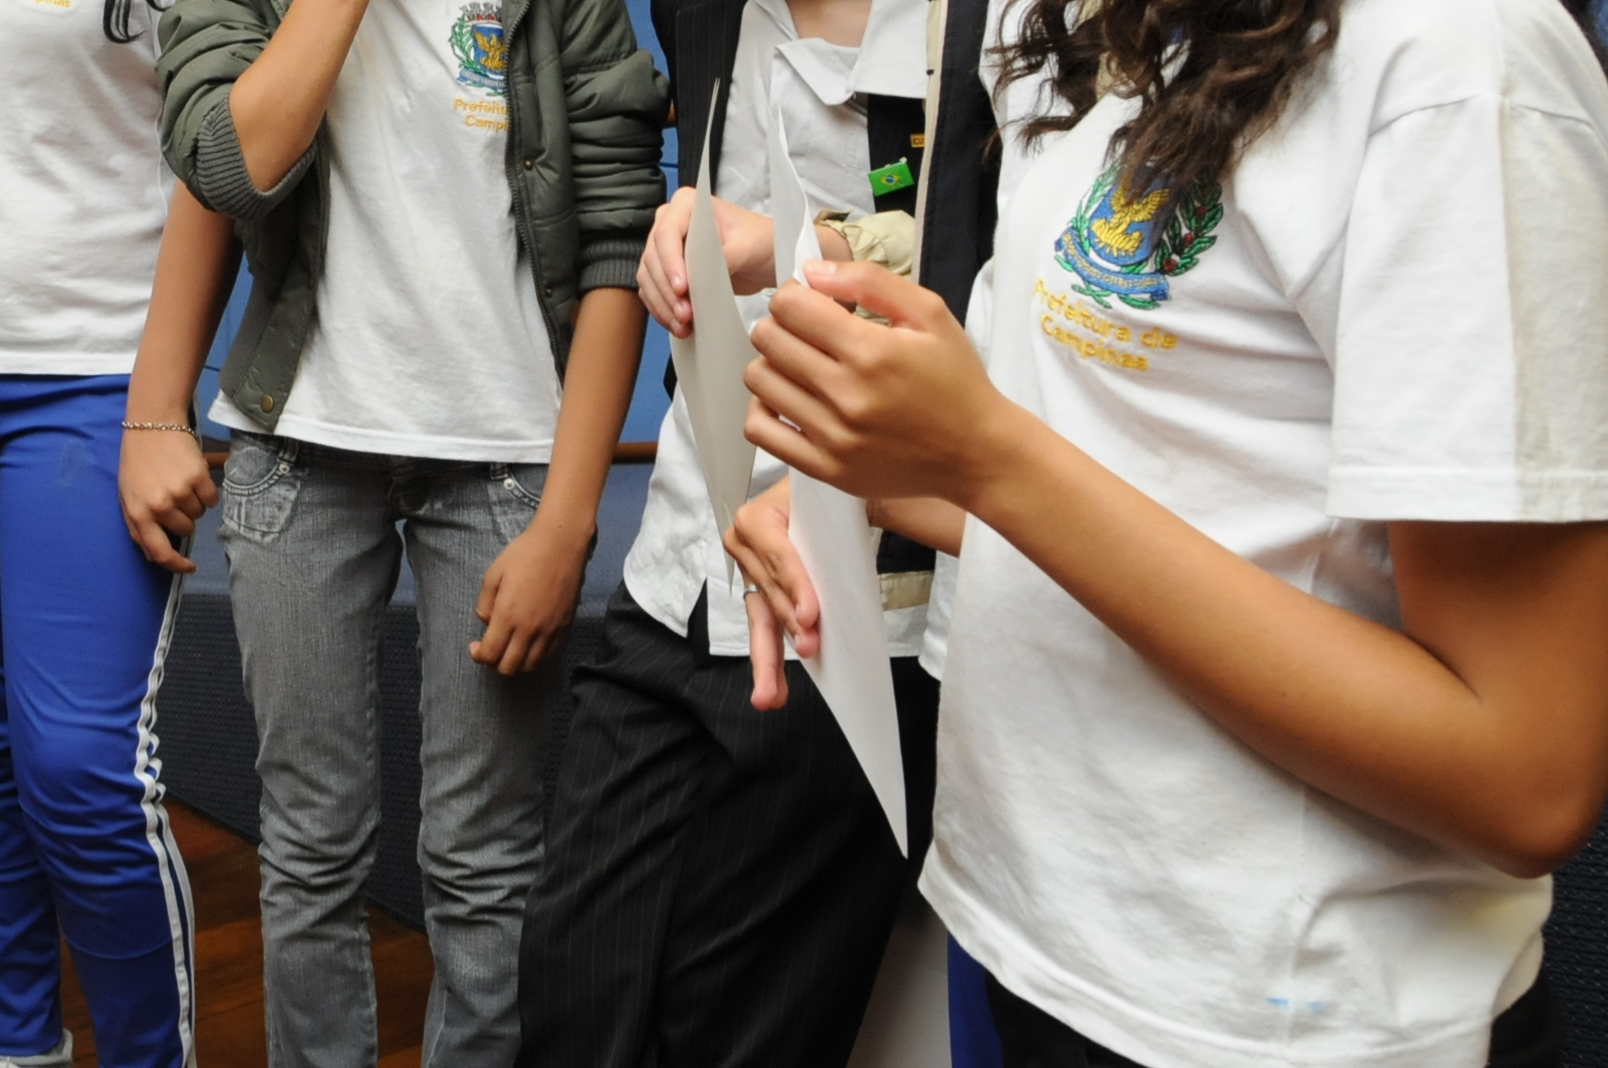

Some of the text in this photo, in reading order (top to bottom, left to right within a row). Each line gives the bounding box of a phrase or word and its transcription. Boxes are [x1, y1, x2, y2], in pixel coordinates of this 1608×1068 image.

[1032, 277, 1178, 350] Prefeitura de
[1040, 314, 1149, 371] Campinas
